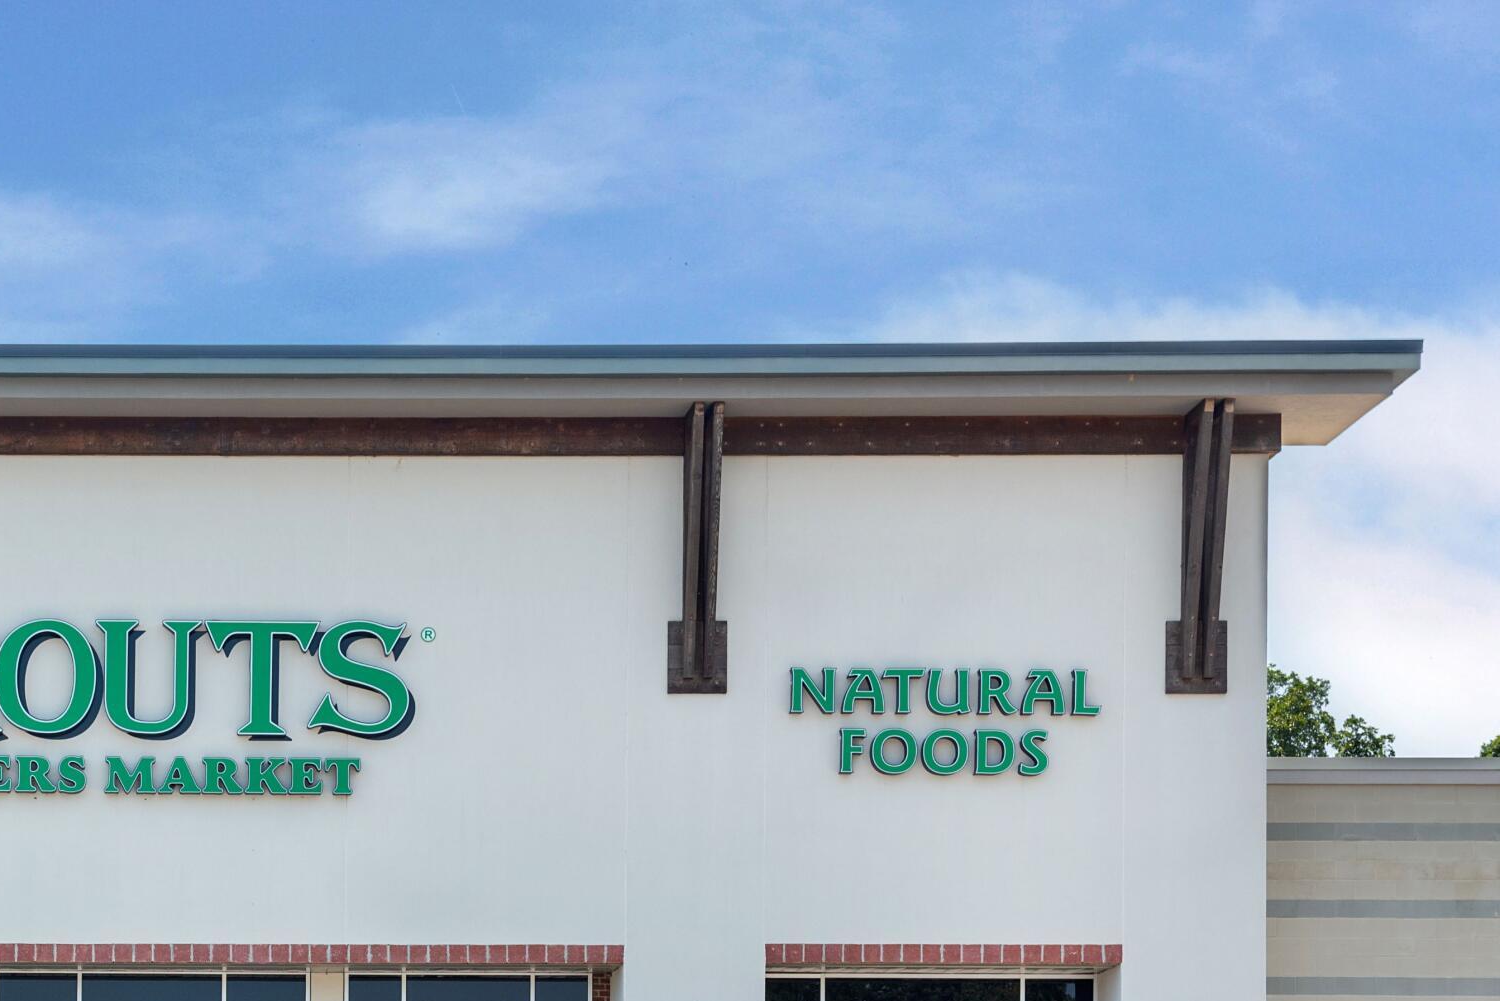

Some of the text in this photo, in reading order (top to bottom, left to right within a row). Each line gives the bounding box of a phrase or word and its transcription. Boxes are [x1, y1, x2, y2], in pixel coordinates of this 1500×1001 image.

[788, 667, 1103, 716] NATURAL
[104, 754, 362, 797] MARKET
[838, 728, 1050, 776] FOODS
